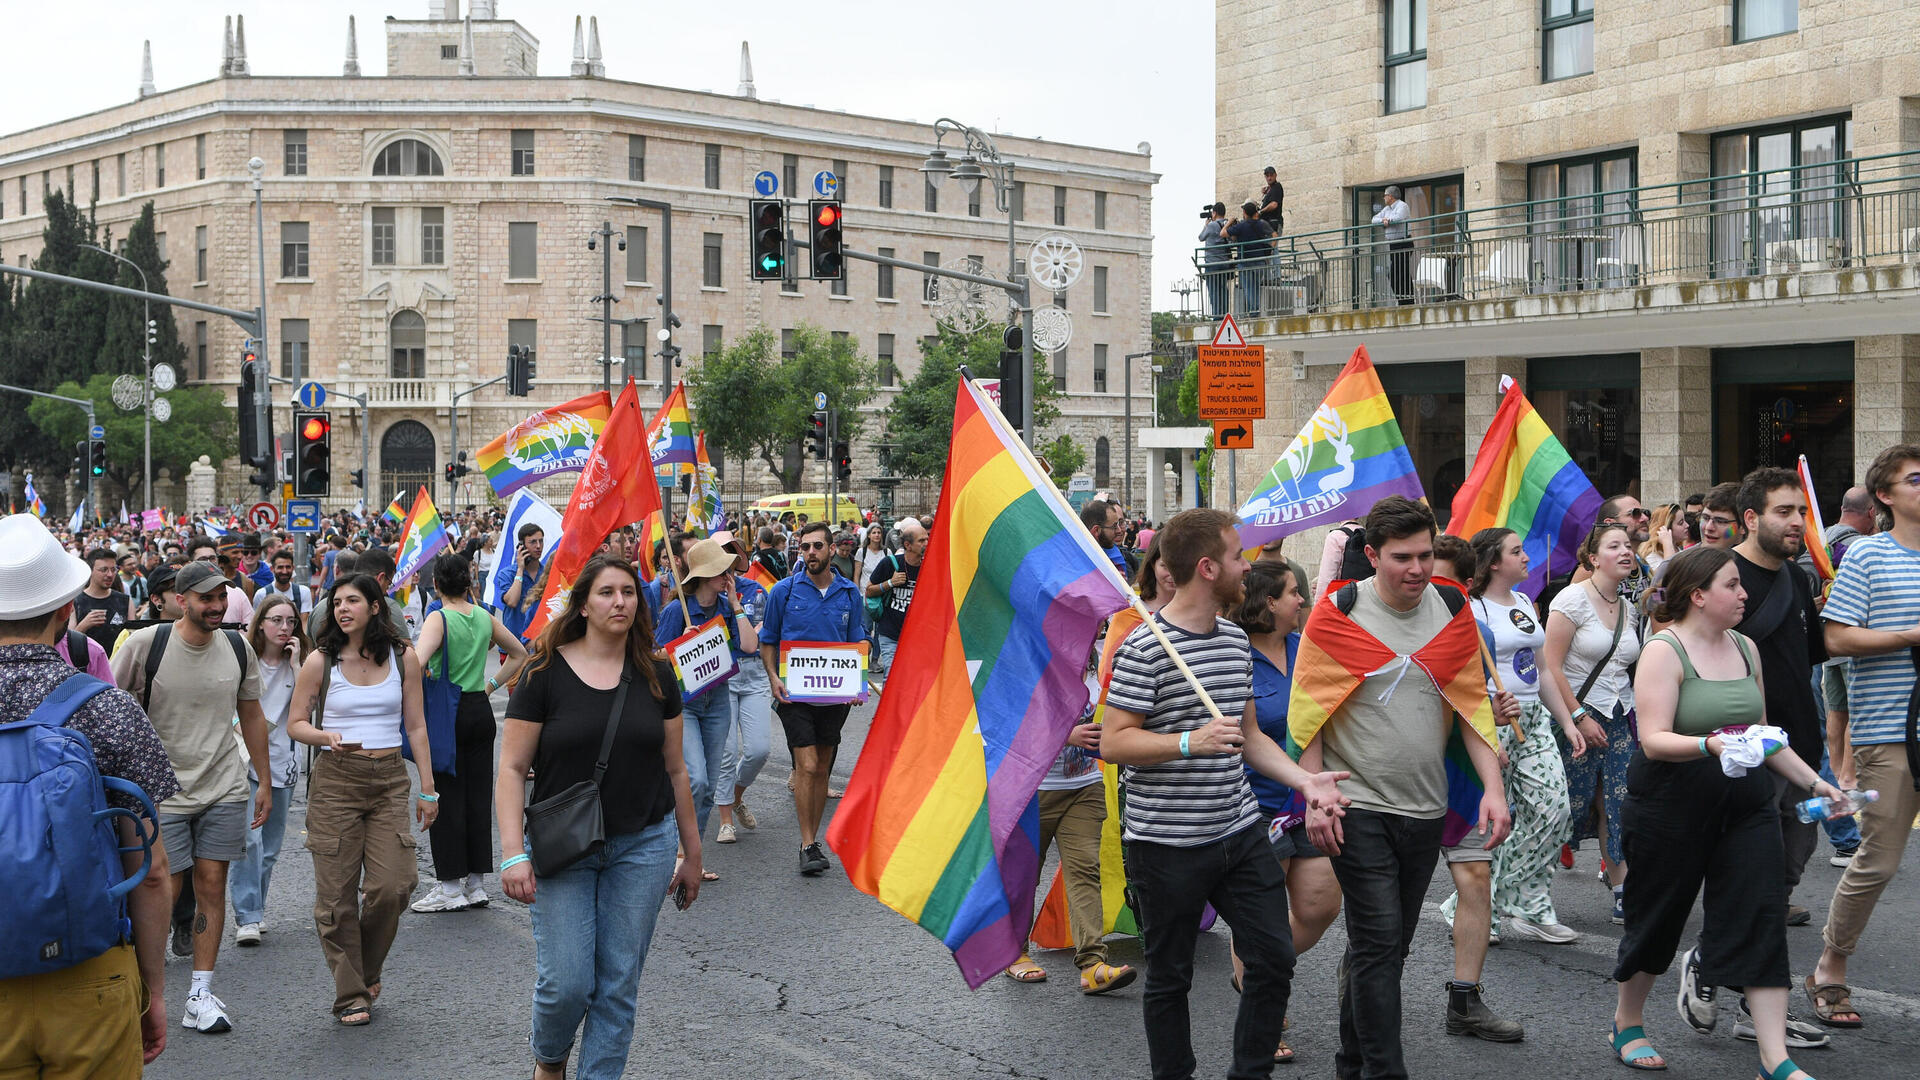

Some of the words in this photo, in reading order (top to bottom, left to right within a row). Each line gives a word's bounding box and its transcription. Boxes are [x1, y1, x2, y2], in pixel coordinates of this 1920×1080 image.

[1203, 349, 1230, 357] מאיטות
[1232, 349, 1260, 357] משאיות
[1202, 358, 1227, 367] משמאל
[1229, 359, 1262, 367] משתלבות
[1207, 395, 1230, 403] TRUCKS
[1231, 395, 1258, 403] SLOWING
[1201, 407, 1229, 416] MERGING
[1230, 407, 1247, 416] FROM
[1247, 407, 1262, 416] LEFT
[1306, 489, 1342, 514] עלה
[1257, 502, 1304, 525] נעלה
[705, 633, 725, 652] גאה
[678, 643, 705, 667] להיות
[693, 655, 721, 681] שווה
[790, 655, 828, 669] להיות
[831, 657, 858, 669] גאה
[803, 675, 844, 689] שווה
